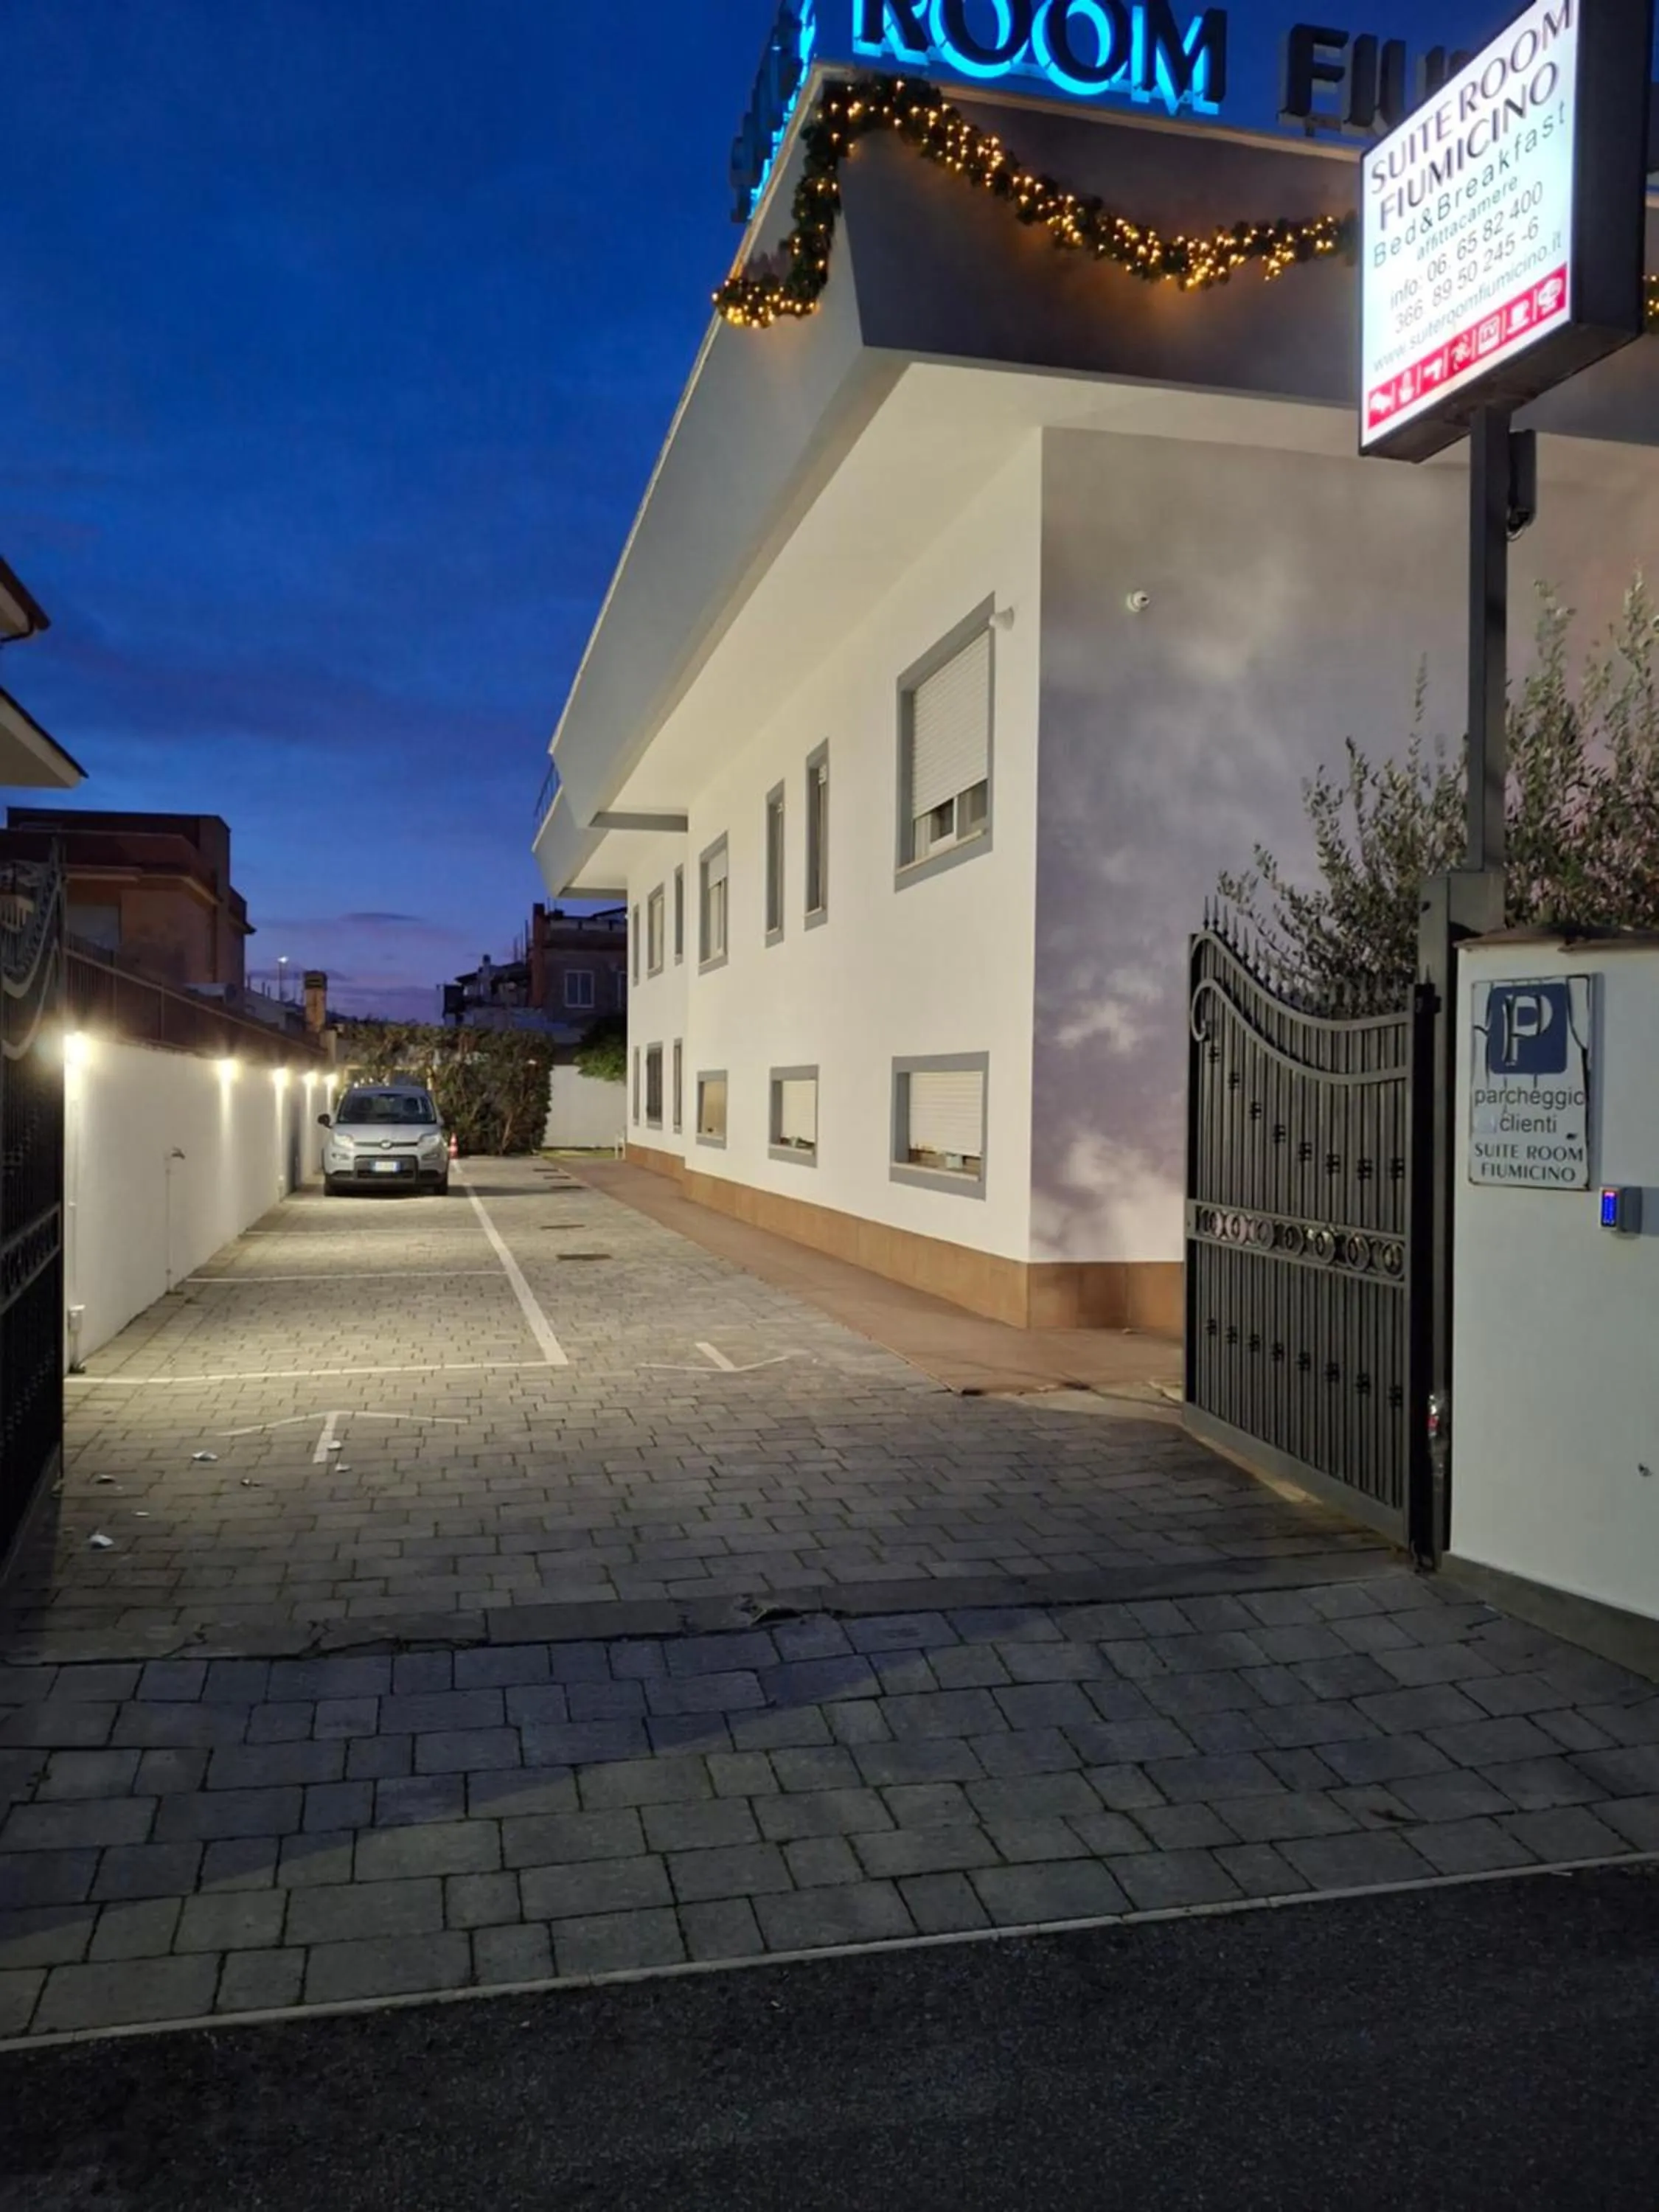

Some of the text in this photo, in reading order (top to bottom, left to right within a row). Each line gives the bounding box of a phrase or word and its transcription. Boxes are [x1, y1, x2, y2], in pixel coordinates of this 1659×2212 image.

[1371, 0, 1571, 195] SUITE ROOM
[1374, 101, 1565, 268] Bed&Breakfast
[1380, 61, 1559, 232] FIUMICINO
[1417, 176, 1517, 261] affittacamere
[1457, 229, 1478, 261] 65
[1483, 211, 1503, 243] 82
[1509, 181, 1543, 220] 400
[1374, 230, 1562, 372] www.suiteroomfiumicino.it
[1433, 278, 1453, 307] 89
[1458, 261, 1478, 290] 50
[1483, 231, 1515, 272] 245
[1502, 994, 1553, 1067] P
[1475, 1143, 1583, 1162] SUITE ROOM
[1500, 1113, 1557, 1133] clienti
[1481, 1162, 1576, 1183] FIUMICINO
